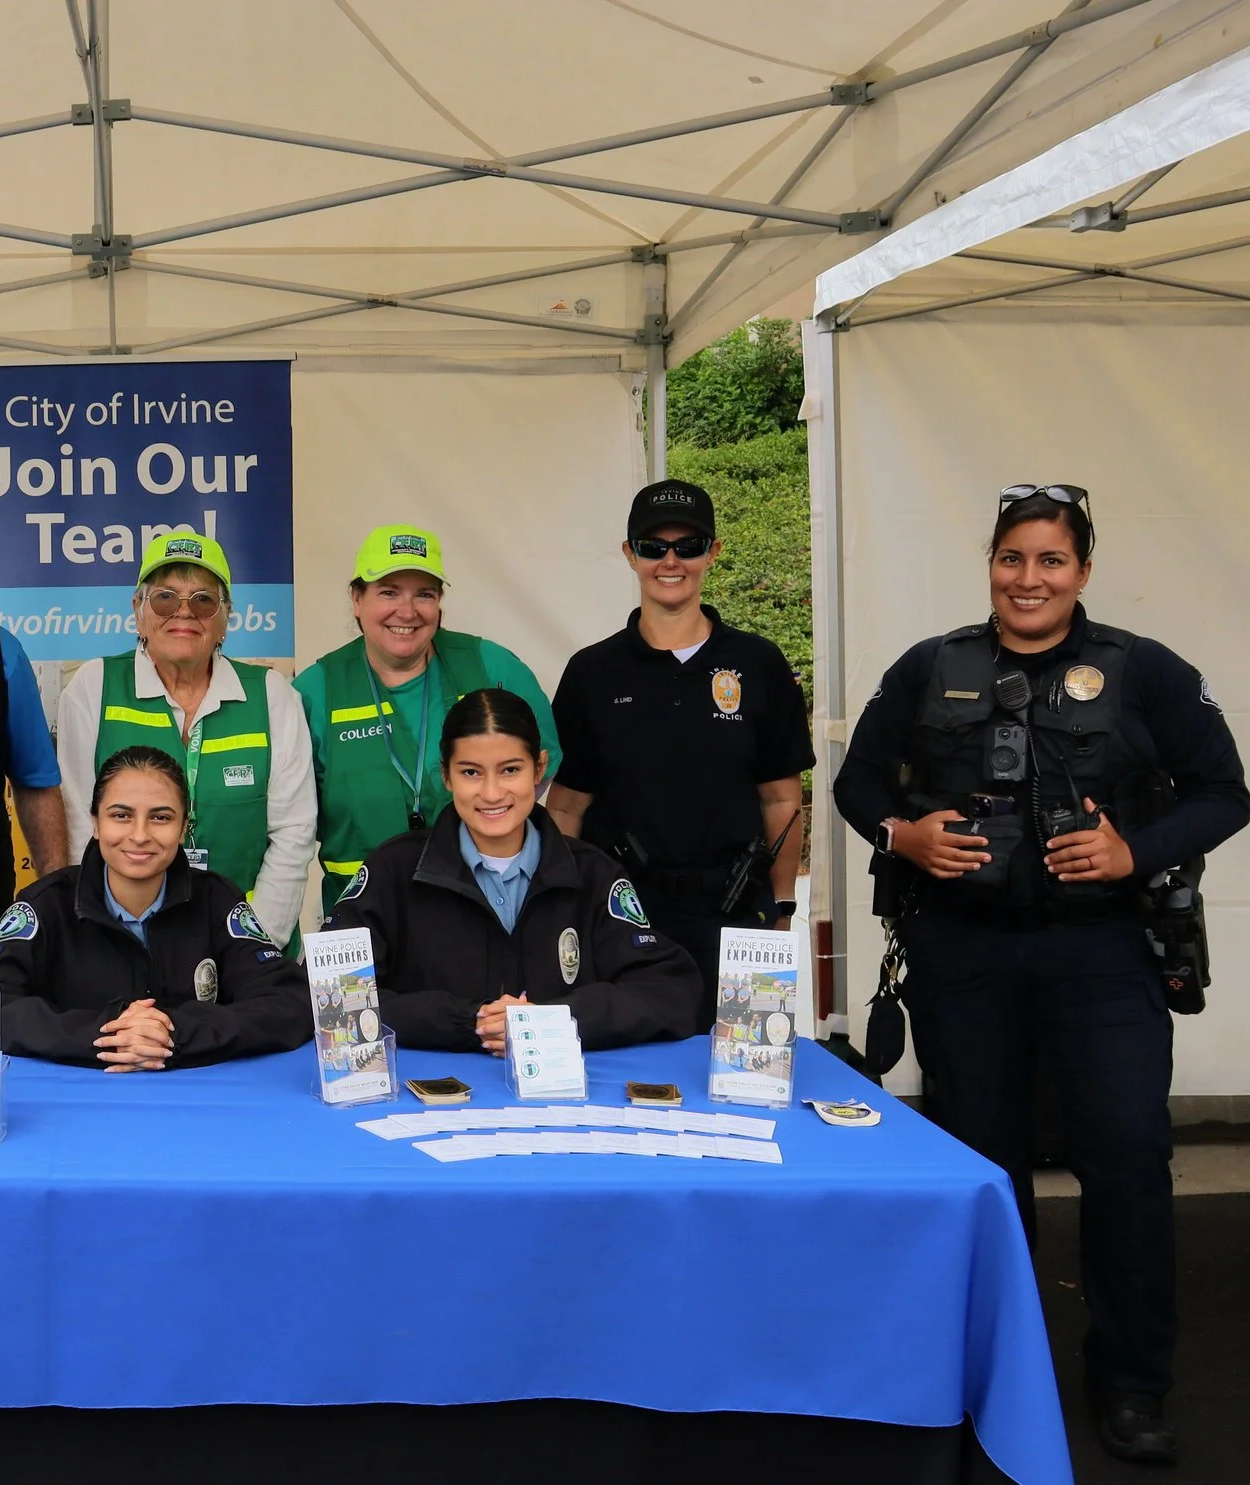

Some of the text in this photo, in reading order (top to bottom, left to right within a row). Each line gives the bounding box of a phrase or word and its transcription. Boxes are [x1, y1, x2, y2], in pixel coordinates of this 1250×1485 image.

[5, 392, 235, 435] City of Irvine
[136, 442, 258, 495] Our
[653, 493, 692, 503] POLICE
[713, 712, 743, 721] POLICE
[339, 723, 392, 742] COLLEEN
[21, 857, 34, 870] 2
[313, 944, 338, 955] IRVINE
[340, 940, 367, 952] POLICE
[727, 940, 794, 952] IRVINE POLICE
[314, 950, 369, 968] EXPLORERS
[727, 949, 793, 965] EXPLORERS
